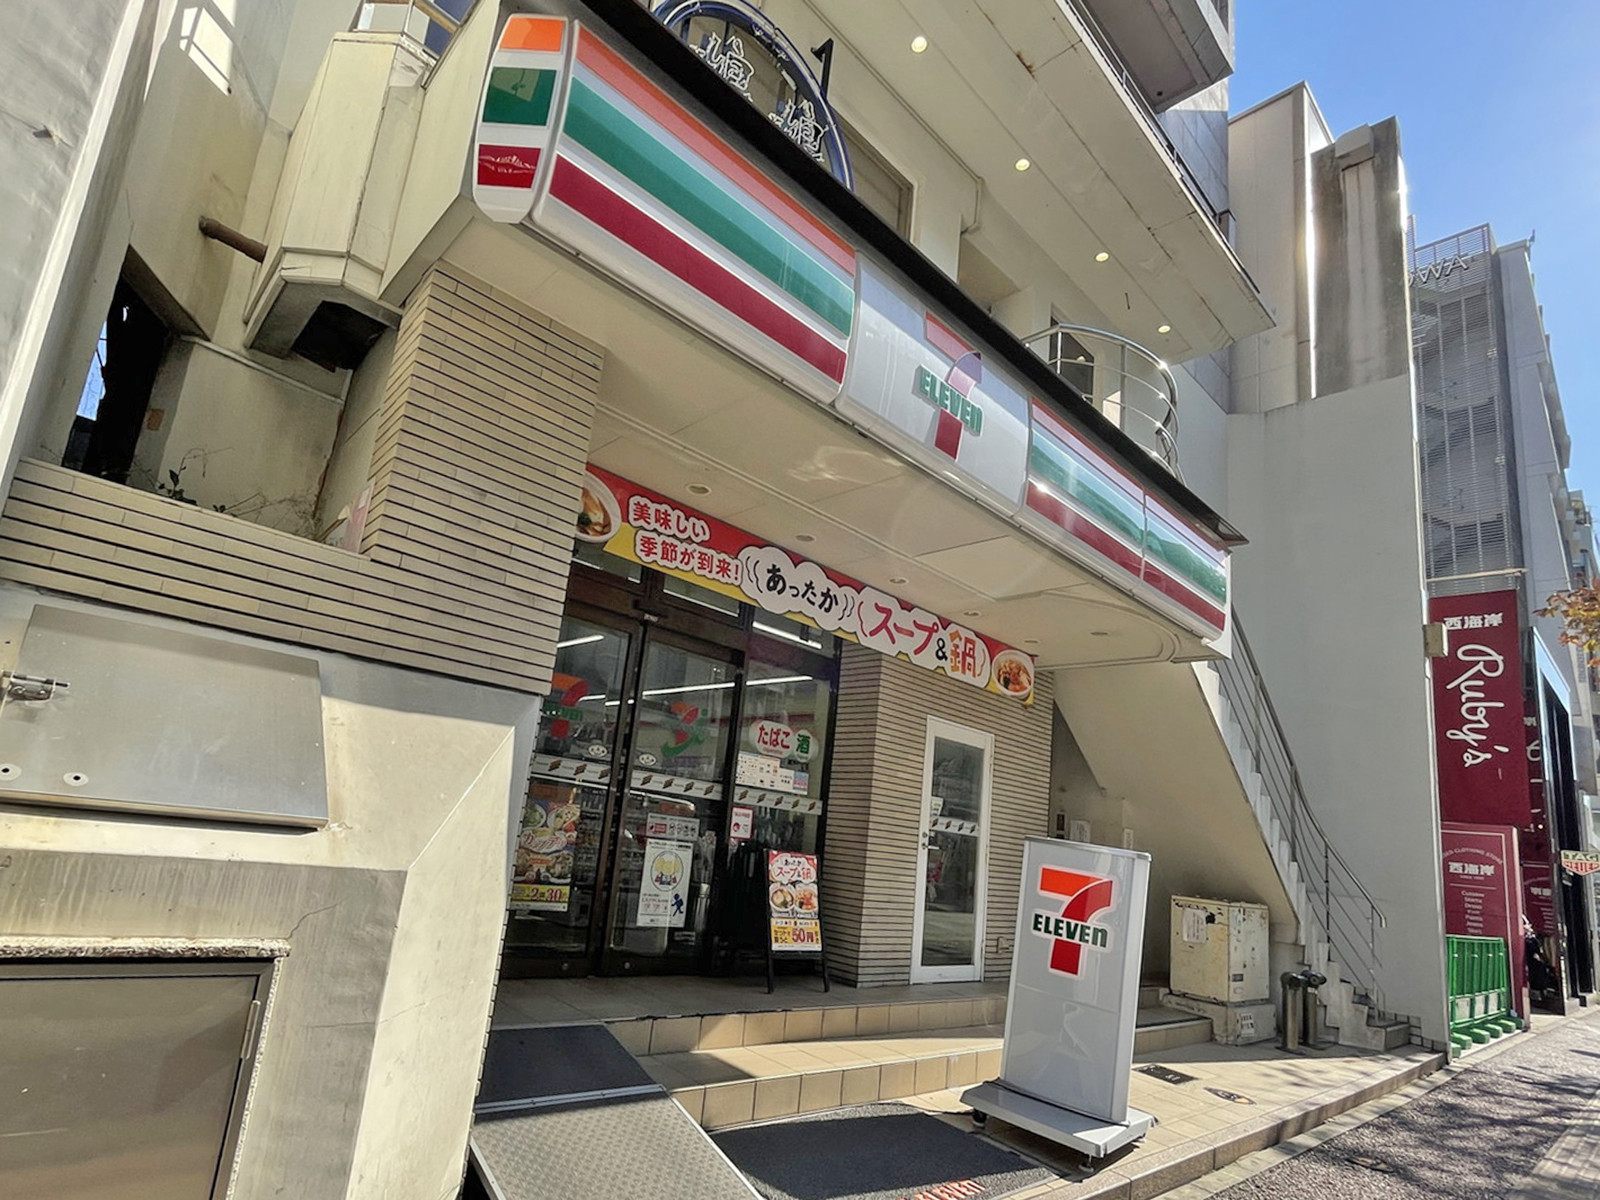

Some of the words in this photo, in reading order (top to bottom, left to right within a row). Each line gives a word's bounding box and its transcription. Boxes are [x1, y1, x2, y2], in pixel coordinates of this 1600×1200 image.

[633, 501, 707, 537] 美味しい
[639, 535, 740, 581] 季節が到来!
[766, 564, 839, 613] あったか
[1444, 612, 1504, 630] 西海岸
[1446, 644, 1510, 767] Ruby's
[757, 724, 791, 749] たばこ
[796, 733, 811, 755] 酒
[1565, 851, 1599, 862] TAG
